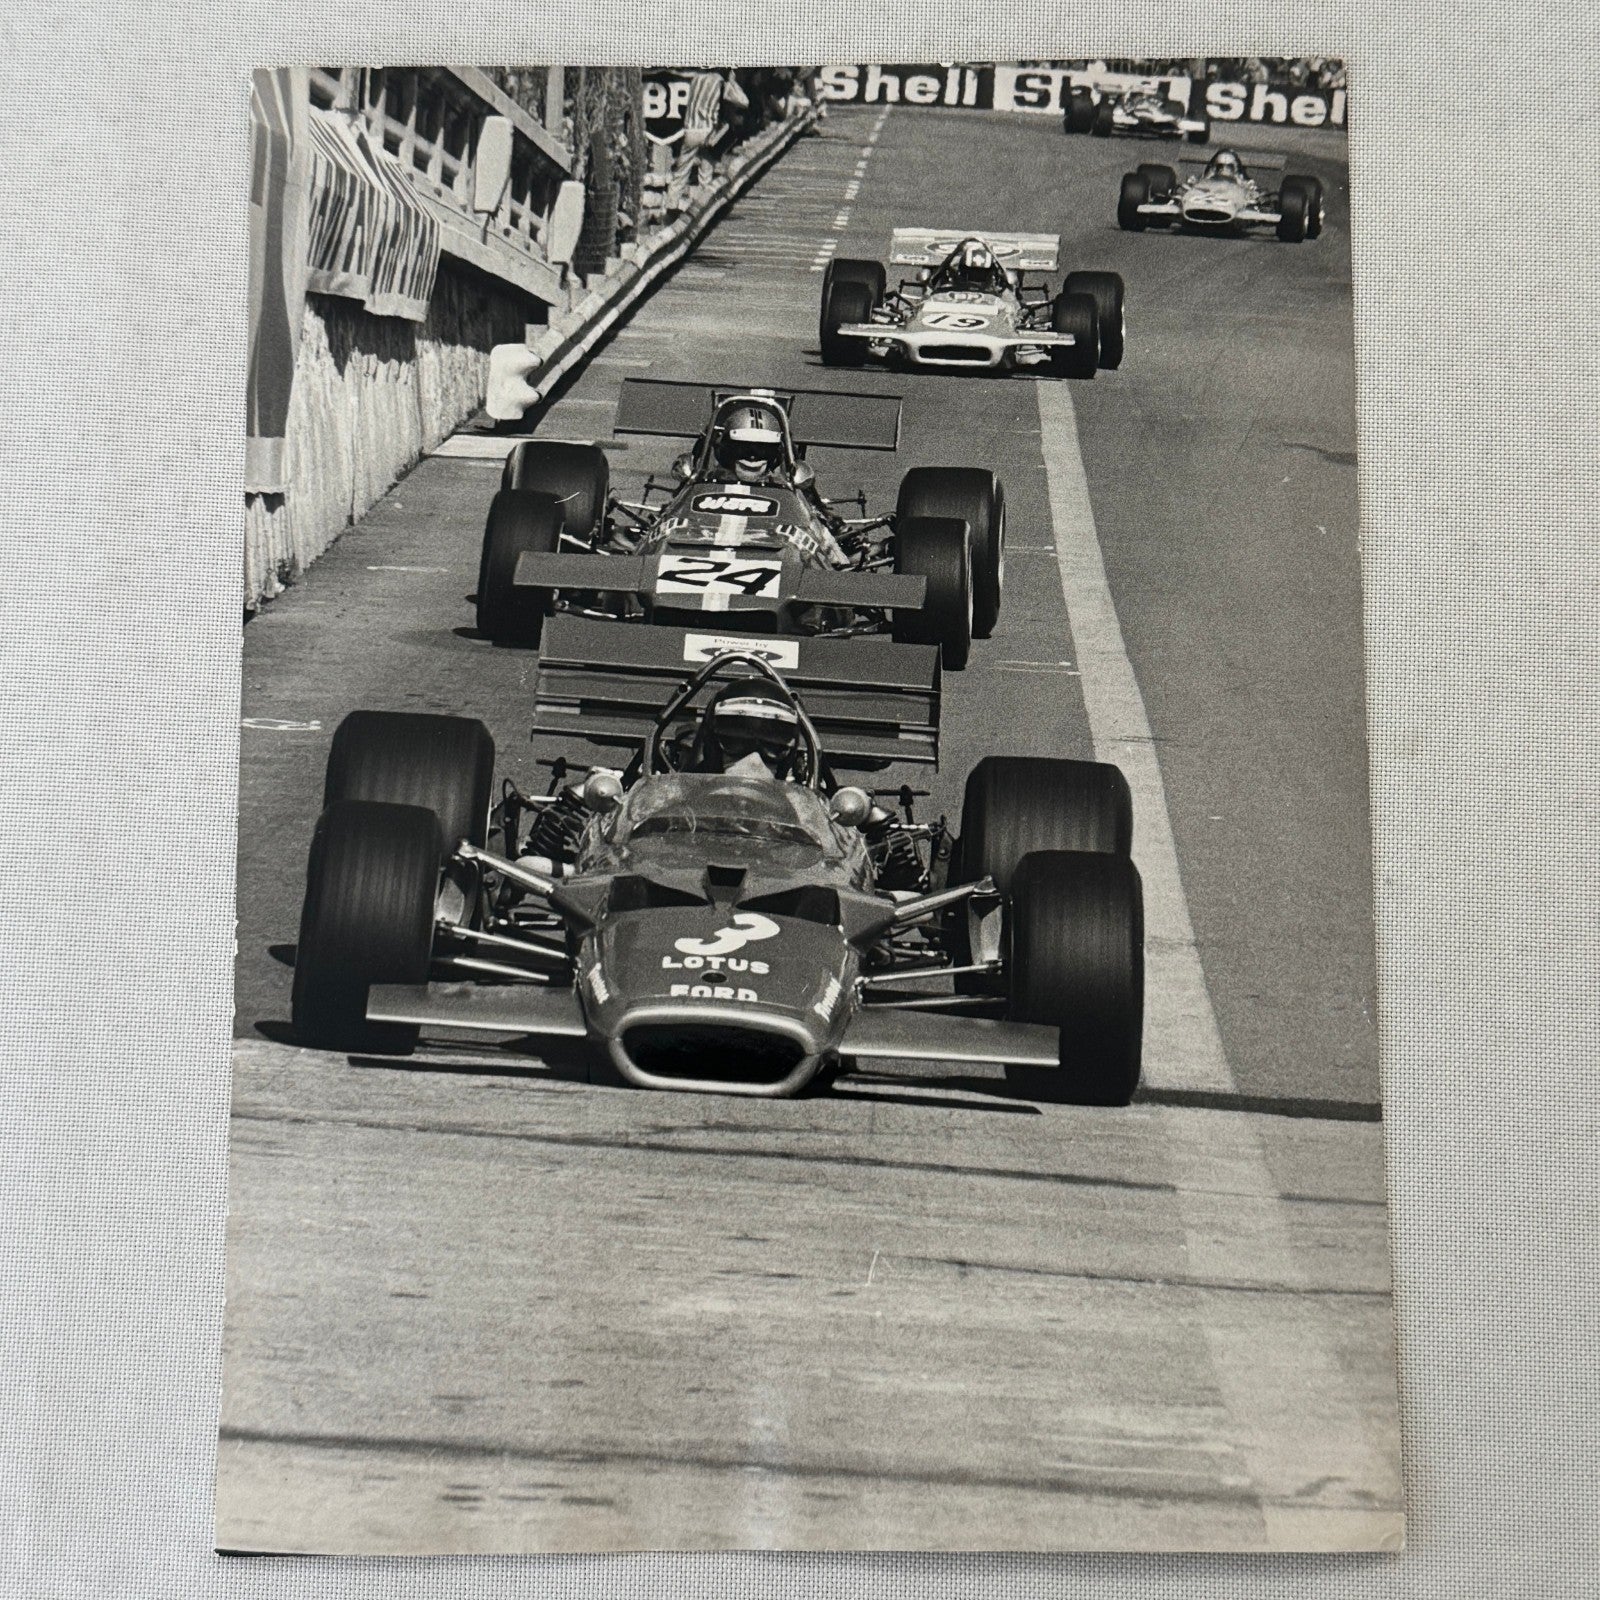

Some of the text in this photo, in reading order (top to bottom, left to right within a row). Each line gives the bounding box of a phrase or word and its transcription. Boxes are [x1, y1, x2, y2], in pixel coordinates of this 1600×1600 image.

[641, 81, 691, 119] BP
[814, 64, 978, 106] Shell
[928, 314, 986, 329] 19
[658, 557, 782, 596] 24
[674, 912, 781, 956] 3
[661, 955, 770, 975] LOTUS
[669, 983, 758, 1002] FORD
